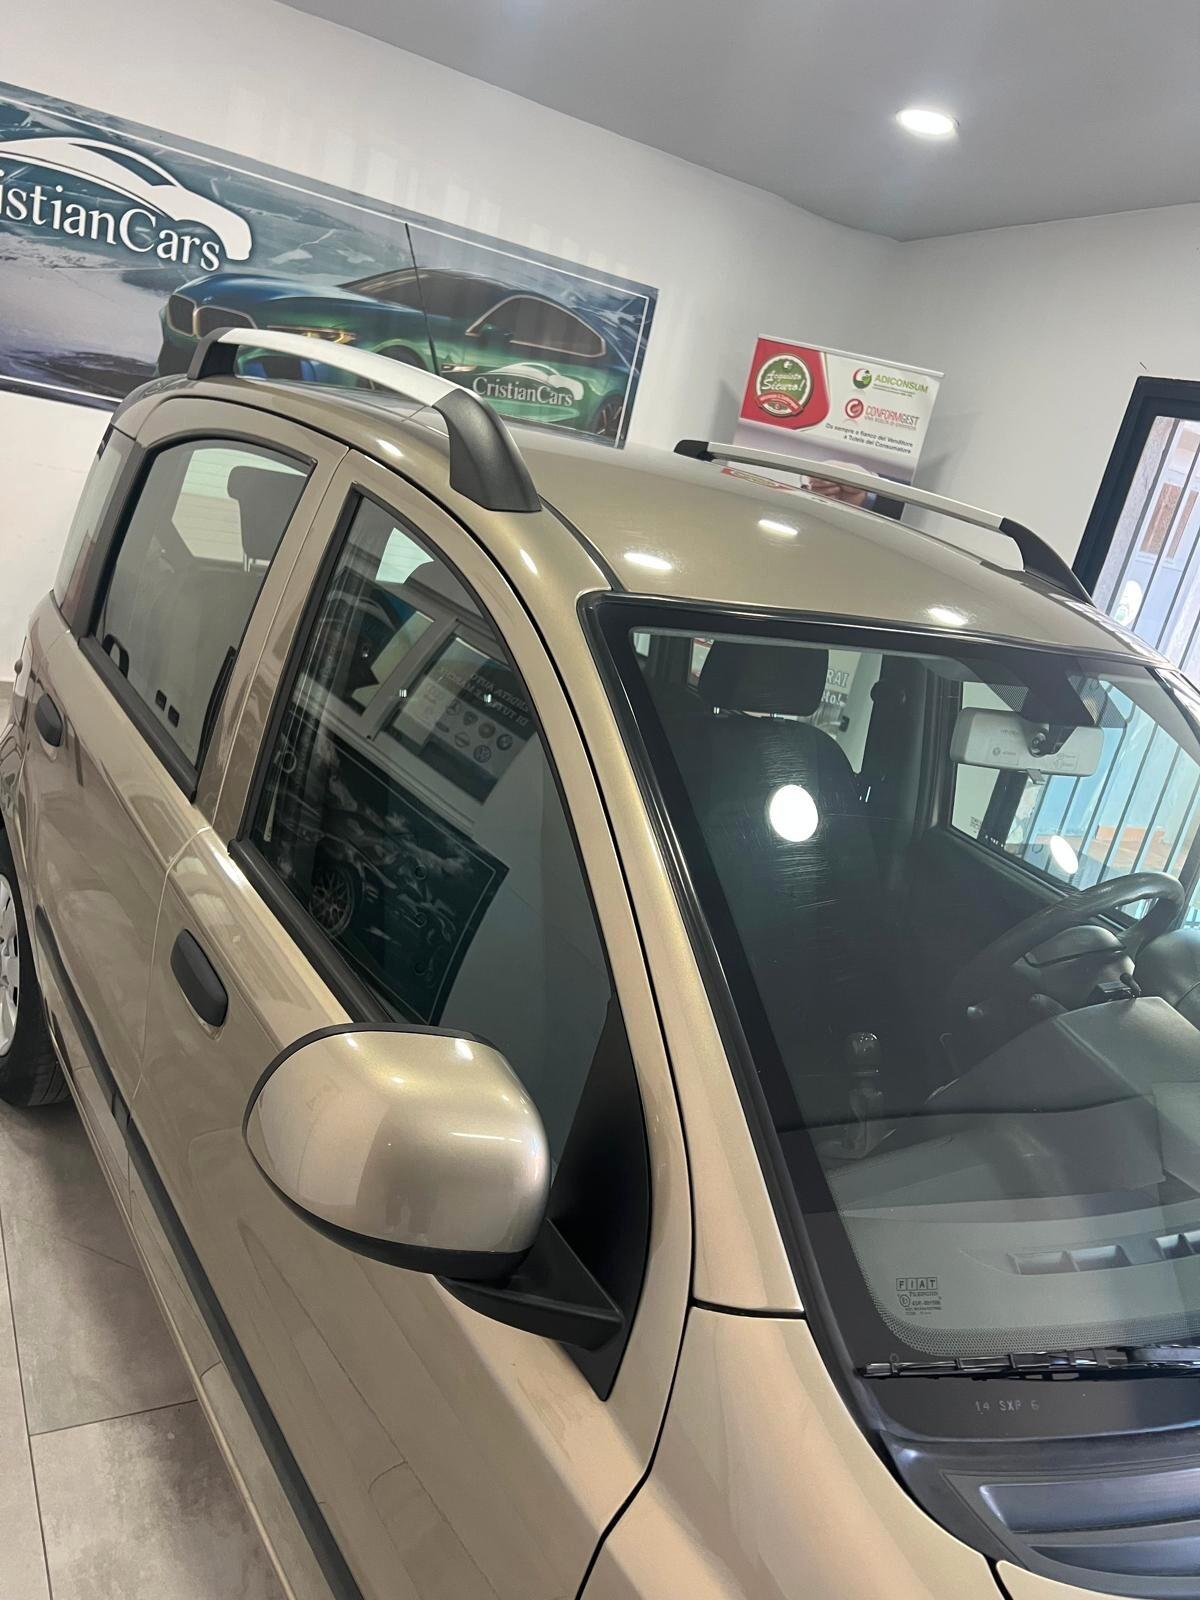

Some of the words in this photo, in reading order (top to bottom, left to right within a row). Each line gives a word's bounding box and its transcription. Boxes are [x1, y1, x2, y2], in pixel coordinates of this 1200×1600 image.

[472, 376, 573, 407] CristianCars
[874, 374, 929, 393] ADICONSUM
[860, 430, 877, 440] fianco
[887, 436, 913, 448] Venditore
[875, 441, 912, 455] Consumatore
[898, 1279, 936, 1289] FIAT
